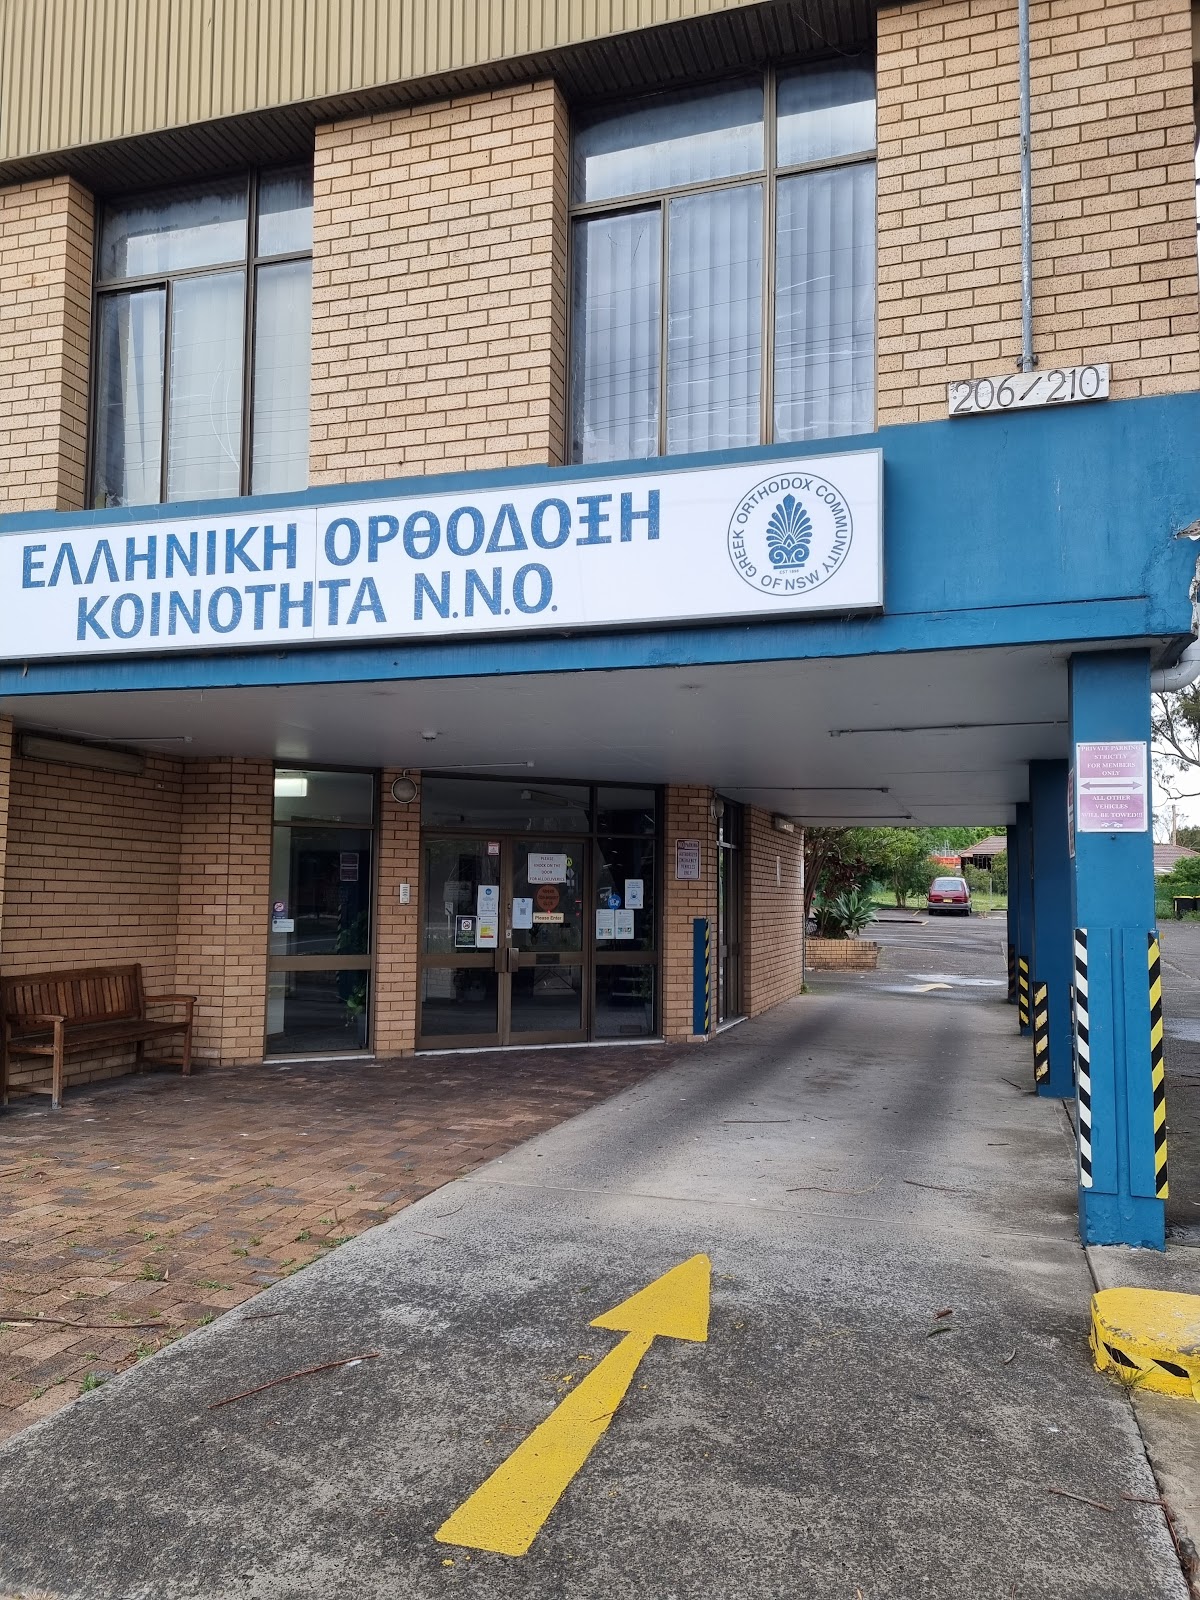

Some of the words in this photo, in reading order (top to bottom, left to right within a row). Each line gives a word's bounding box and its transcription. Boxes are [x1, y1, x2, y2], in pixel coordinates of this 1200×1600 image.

[954, 366, 1100, 412] 206/210
[736, 477, 813, 524] ORTHODOX
[22, 523, 297, 588] ΕΛΛΗΝΙΚΗ
[324, 489, 661, 566] ΟΡΘΟΔΟΞΗ
[732, 529, 757, 578] GREEK
[815, 485, 848, 573] COMMUNITY
[76, 577, 387, 641] ΚΟΙΝΟΤΗΤΑ
[413, 562, 558, 621] Ν.Ν.Ο.
[761, 574, 783, 589] OF
[785, 570, 820, 590] NSW
